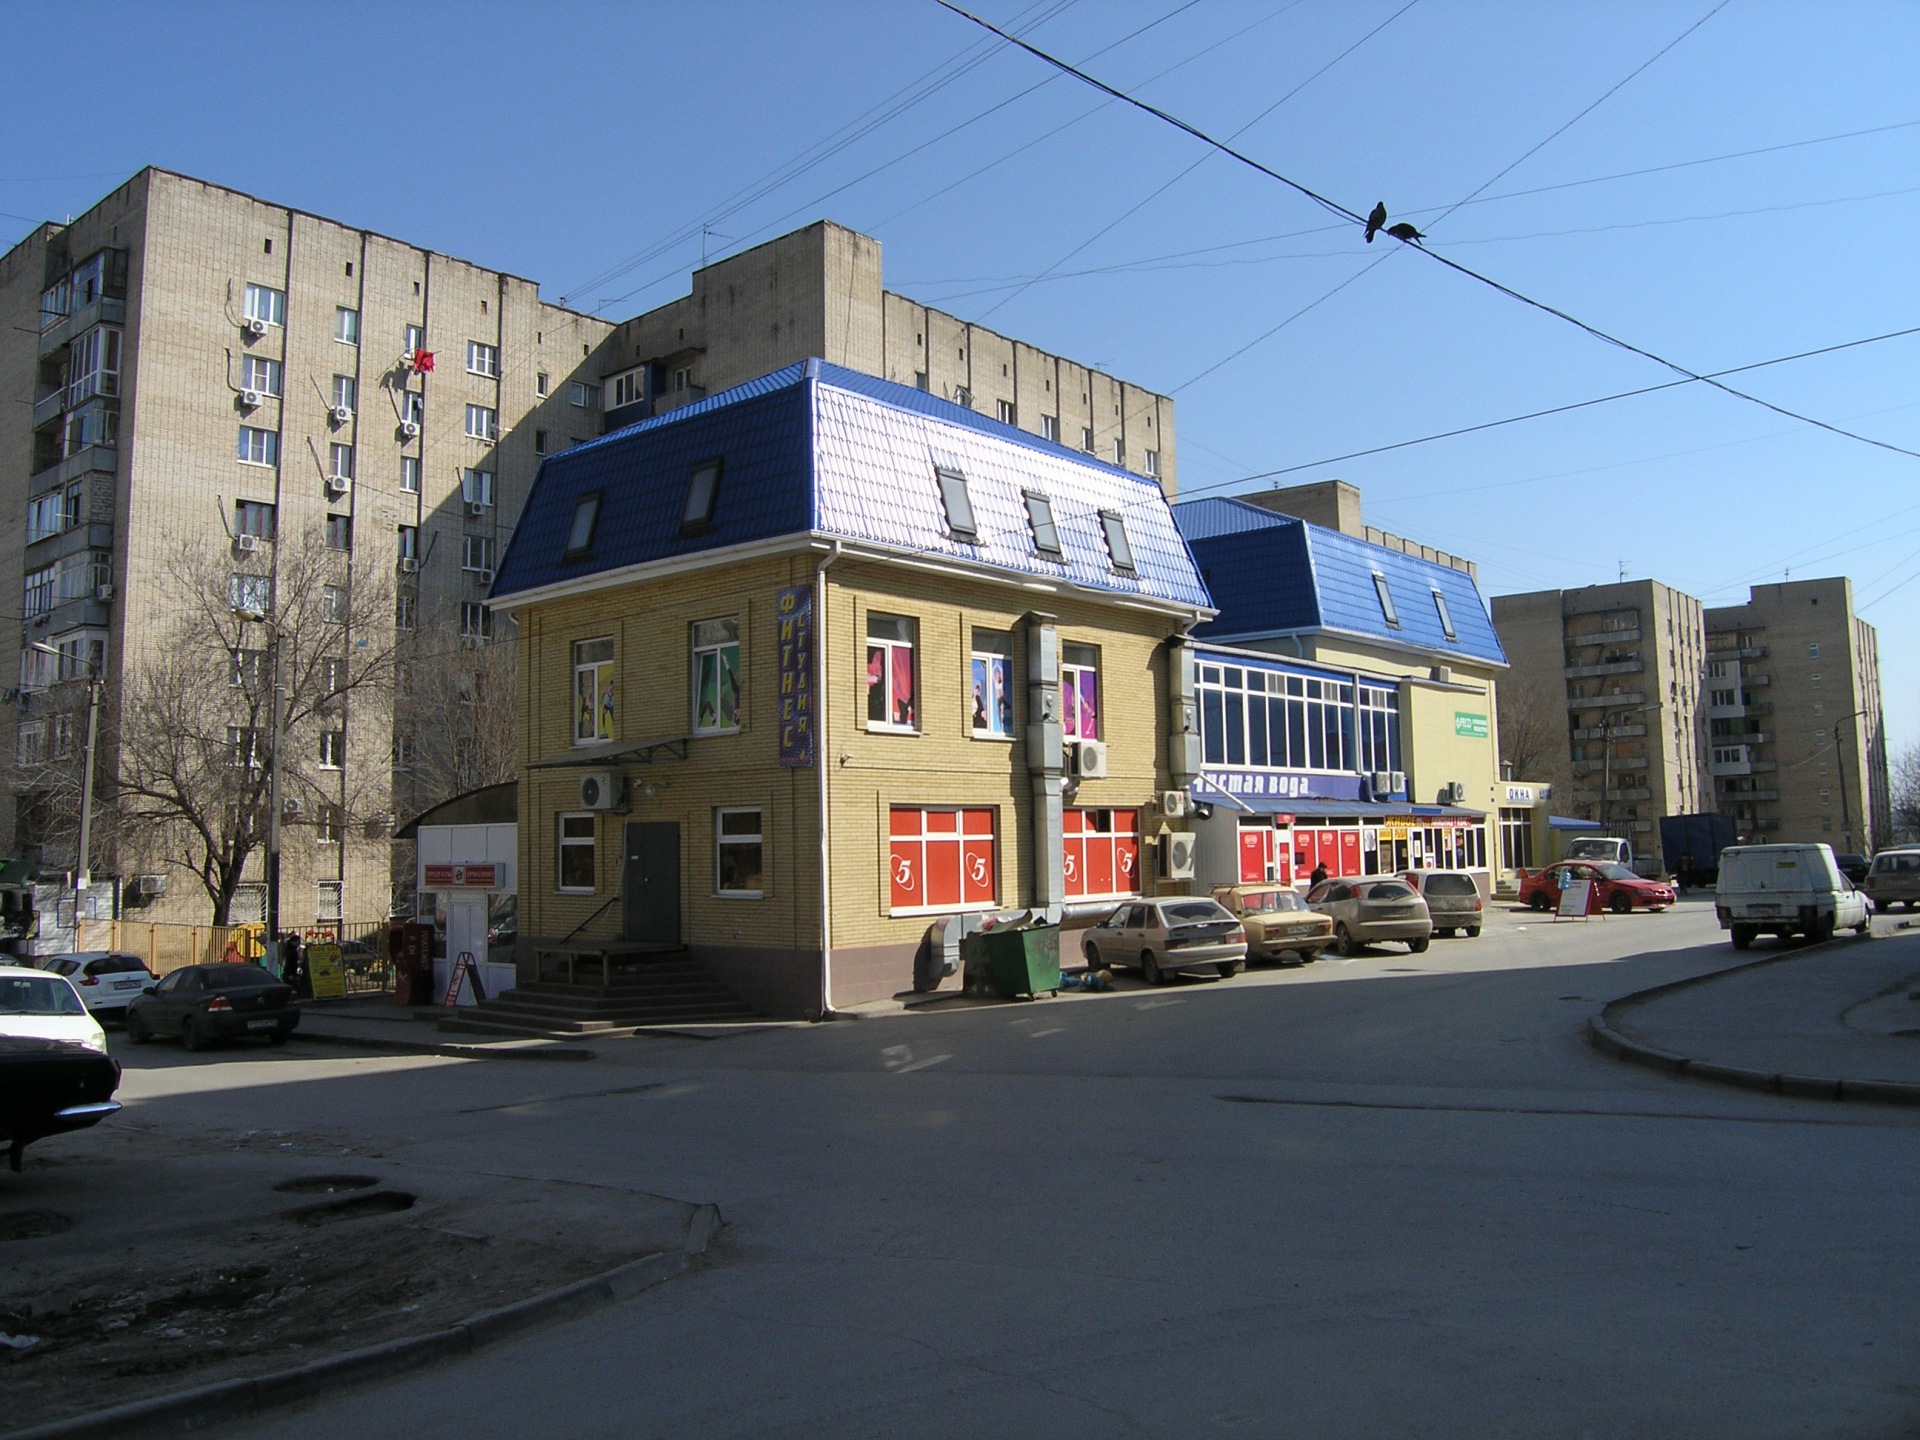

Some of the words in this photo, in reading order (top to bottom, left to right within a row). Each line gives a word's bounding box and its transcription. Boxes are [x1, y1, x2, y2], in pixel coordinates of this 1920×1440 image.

[780, 592, 796, 750] ФИТНЕС
[796, 611, 807, 733] СТУДИЯ
[1268, 776, 1309, 798] вода
[1509, 788, 1530, 800] ОКНА
[1385, 815, 1416, 827] ЖИВОЕ
[896, 860, 912, 884] 5
[972, 858, 986, 881] 5
[1063, 854, 1075, 876] 5
[1121, 852, 1133, 873] 5
